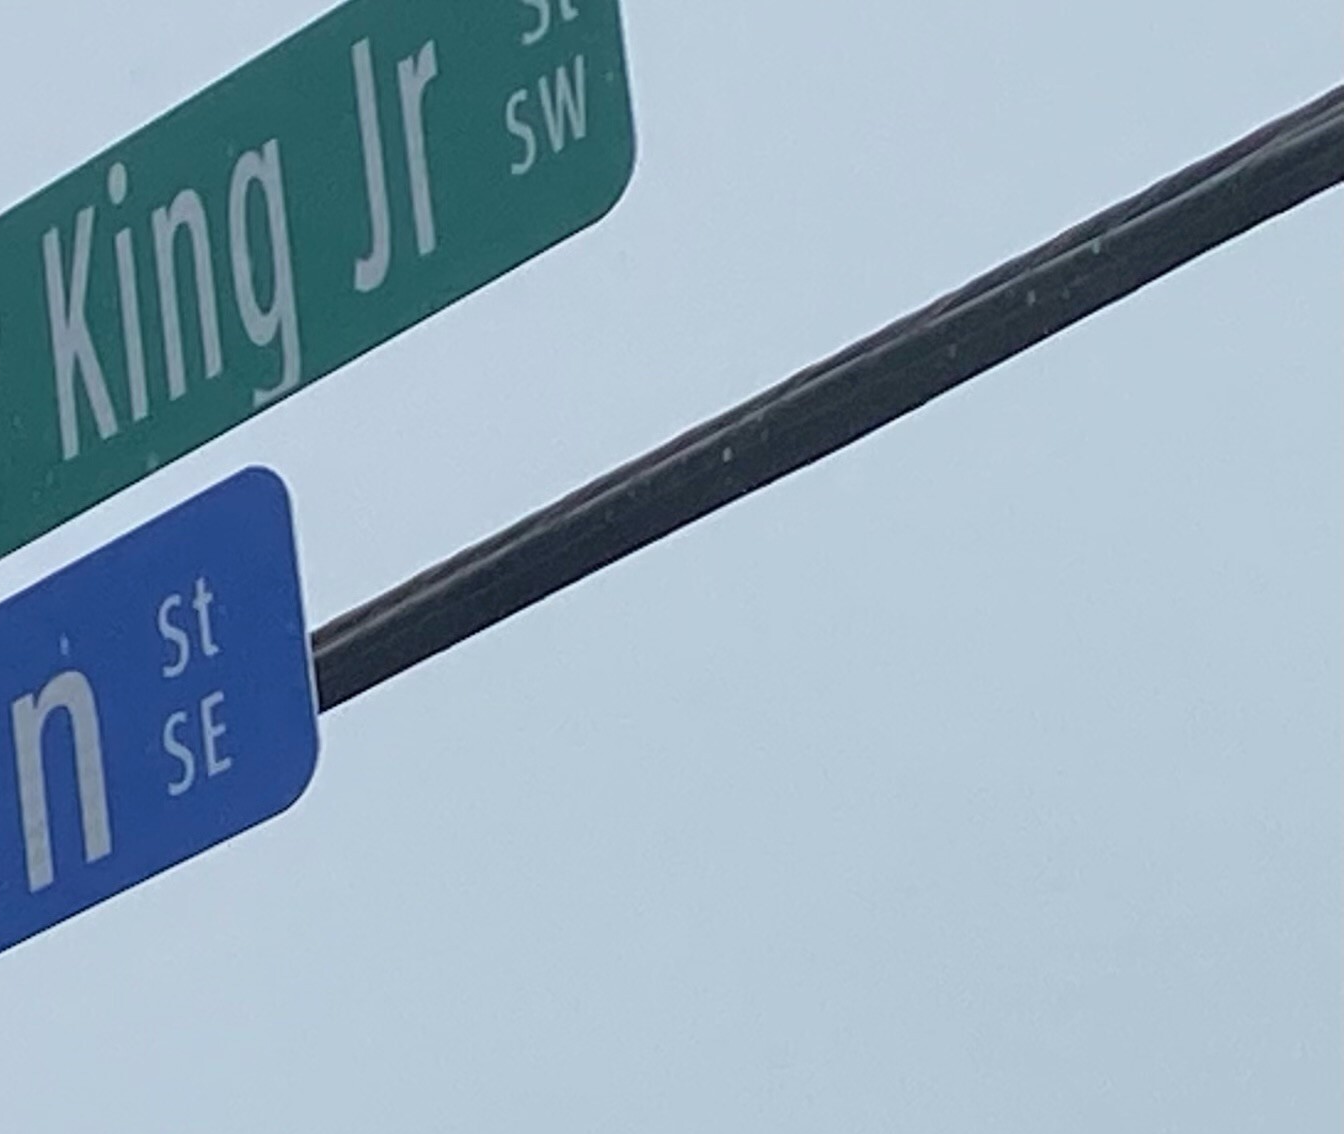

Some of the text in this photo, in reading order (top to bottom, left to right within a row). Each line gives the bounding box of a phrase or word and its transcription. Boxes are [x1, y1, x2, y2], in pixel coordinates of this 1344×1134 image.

[505, 54, 587, 175] SW
[42, 138, 302, 462] King
[350, 38, 439, 293] Jr
[157, 577, 220, 678] St
[162, 690, 232, 796] SE
